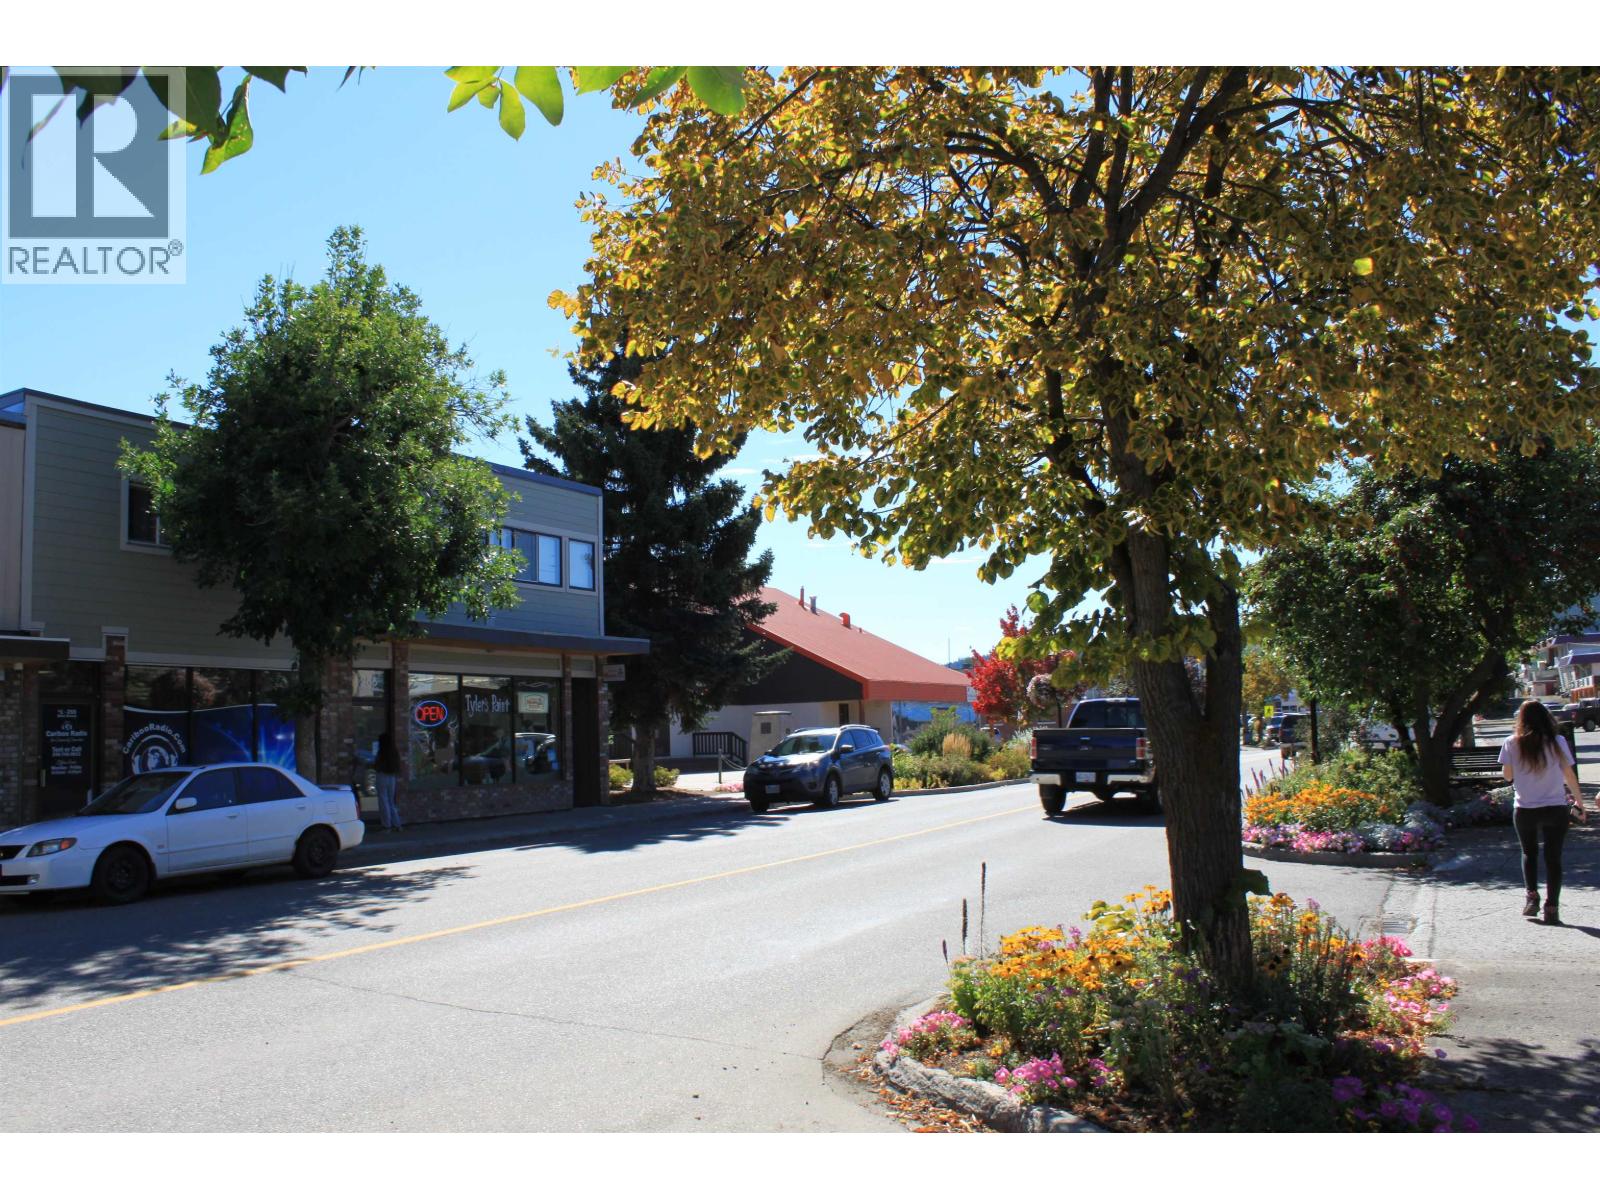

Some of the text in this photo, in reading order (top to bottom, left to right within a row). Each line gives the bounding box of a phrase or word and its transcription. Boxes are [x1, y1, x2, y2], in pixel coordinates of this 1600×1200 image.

[415, 705, 444, 721] OPEN
[464, 693, 490, 718] Tyler's
[122, 723, 186, 754] CaribooRadio.Com
